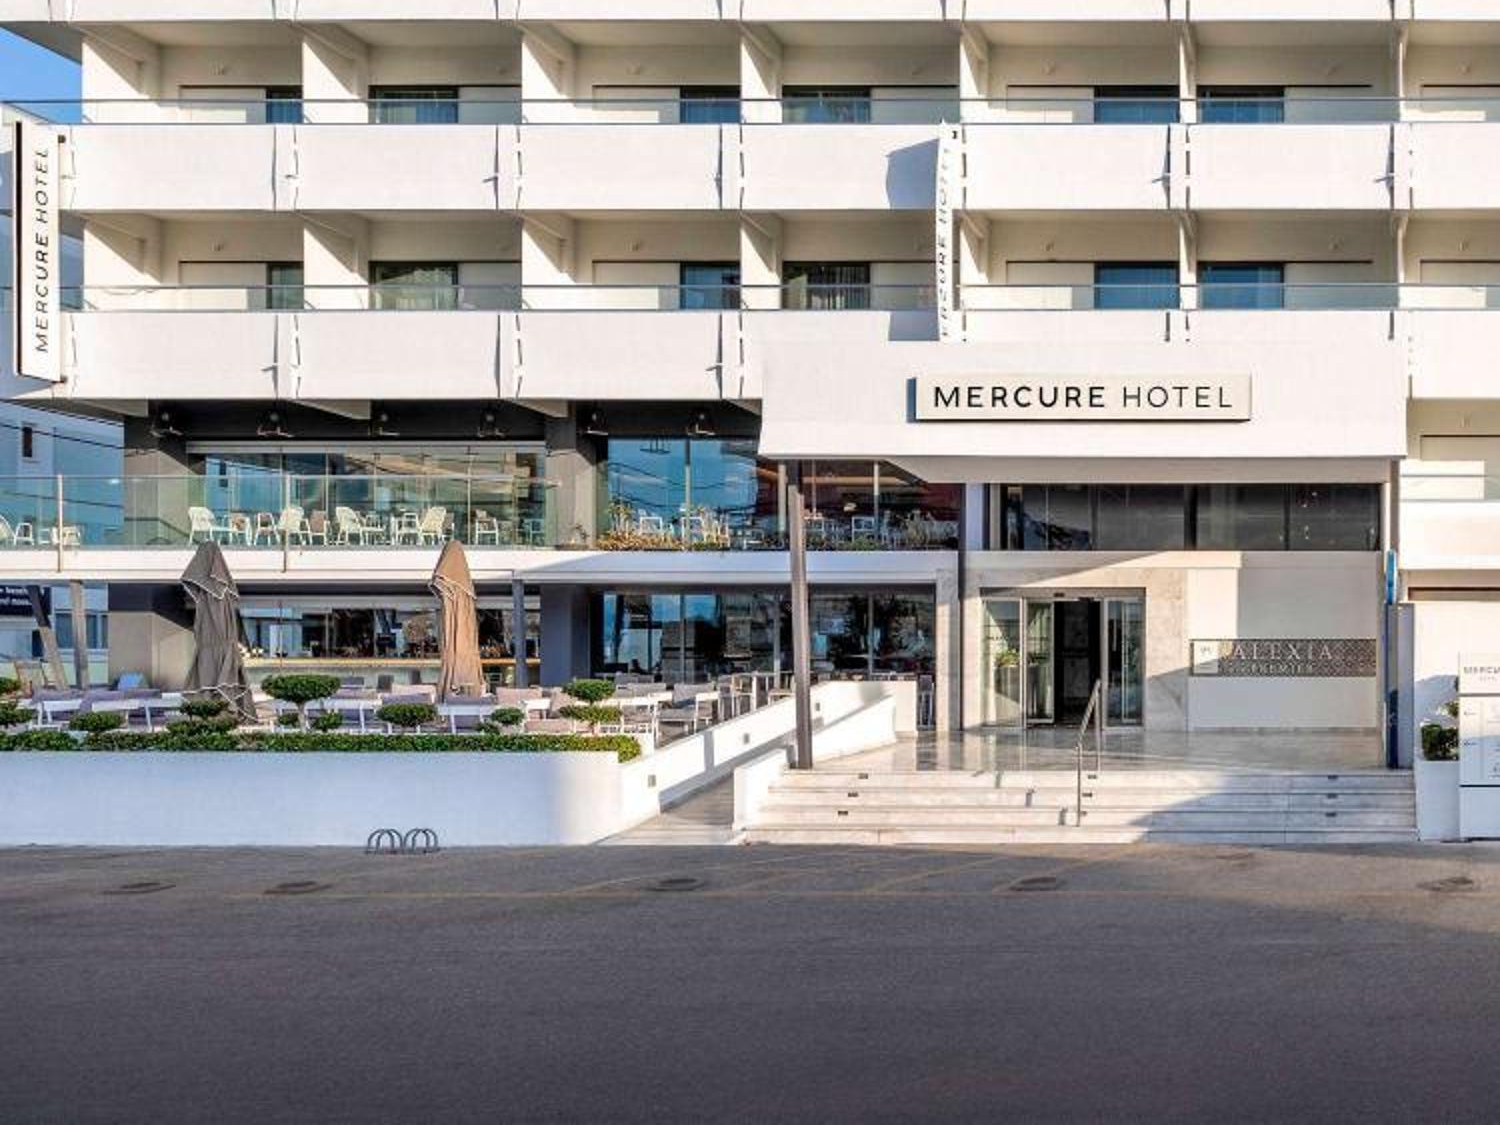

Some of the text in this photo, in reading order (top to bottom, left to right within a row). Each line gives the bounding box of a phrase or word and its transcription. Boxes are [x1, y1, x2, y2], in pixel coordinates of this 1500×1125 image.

[34, 149, 49, 353] MERCURE HOTEL
[934, 386, 1232, 408] MERCURE HOTEL
[1233, 642, 1333, 660] ALEXIA
